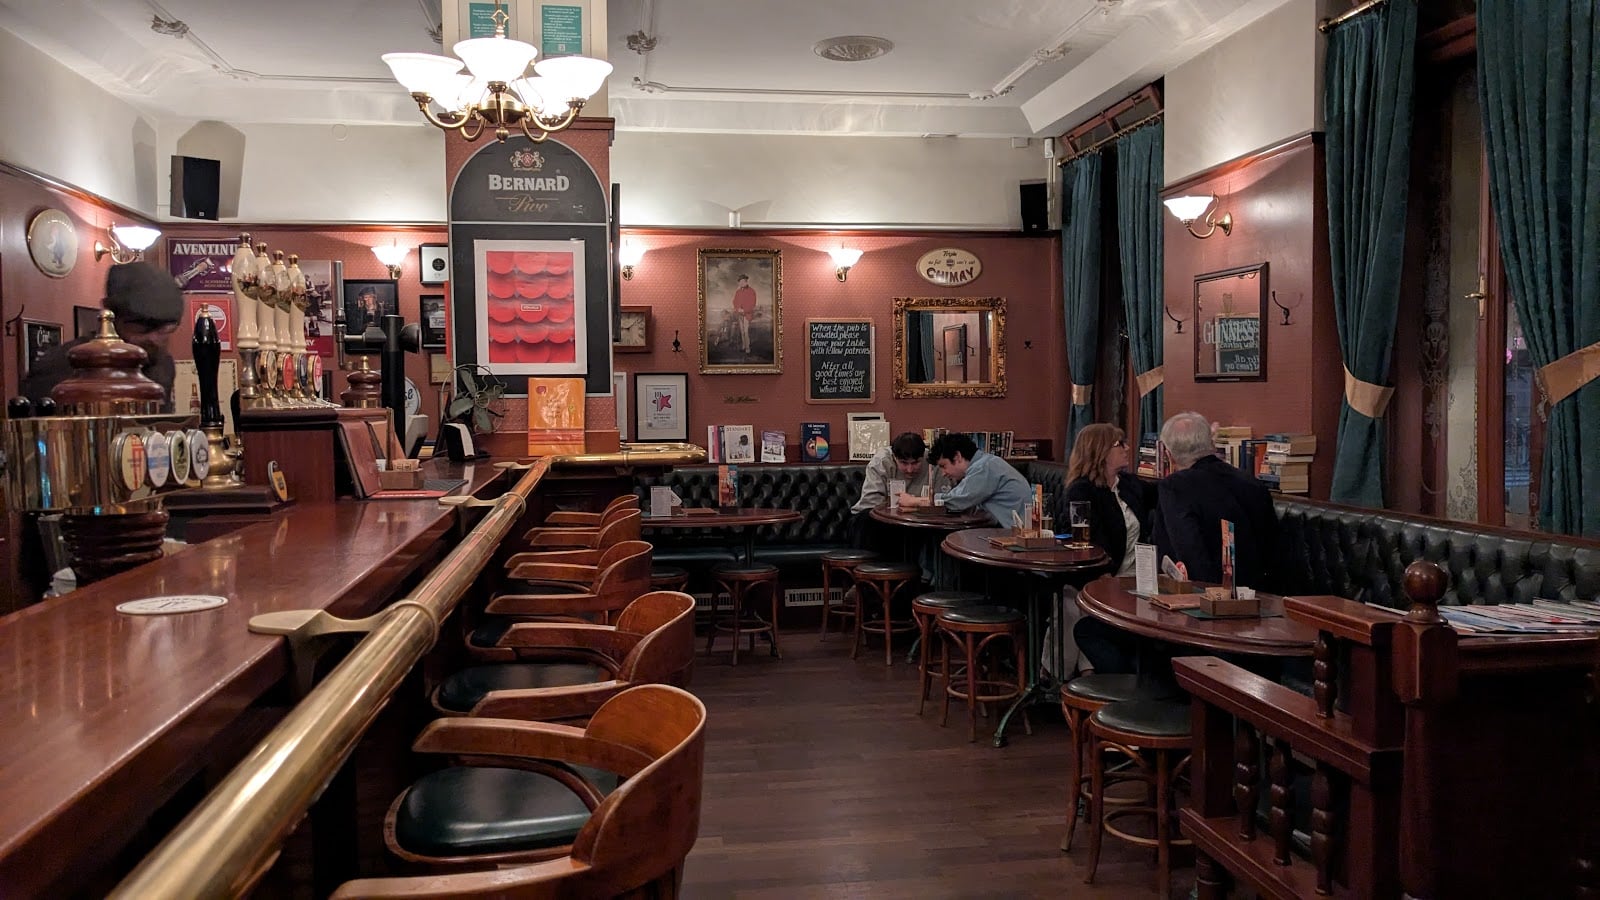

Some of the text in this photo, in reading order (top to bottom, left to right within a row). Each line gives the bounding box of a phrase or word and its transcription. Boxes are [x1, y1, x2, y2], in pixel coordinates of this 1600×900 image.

[488, 174, 570, 192] BERNARD
[508, 193, 548, 213] Pivo
[173, 243, 238, 256] AVENTINU
[926, 266, 974, 282] CHIMAY
[833, 324, 844, 332] the
[847, 324, 860, 333] pub
[838, 331, 860, 340] please
[826, 347, 843, 355] fellow
[821, 361, 840, 370] After
[815, 370, 833, 380] good
[835, 370, 853, 378] times
[822, 376, 837, 385] best
[819, 385, 837, 393] when
